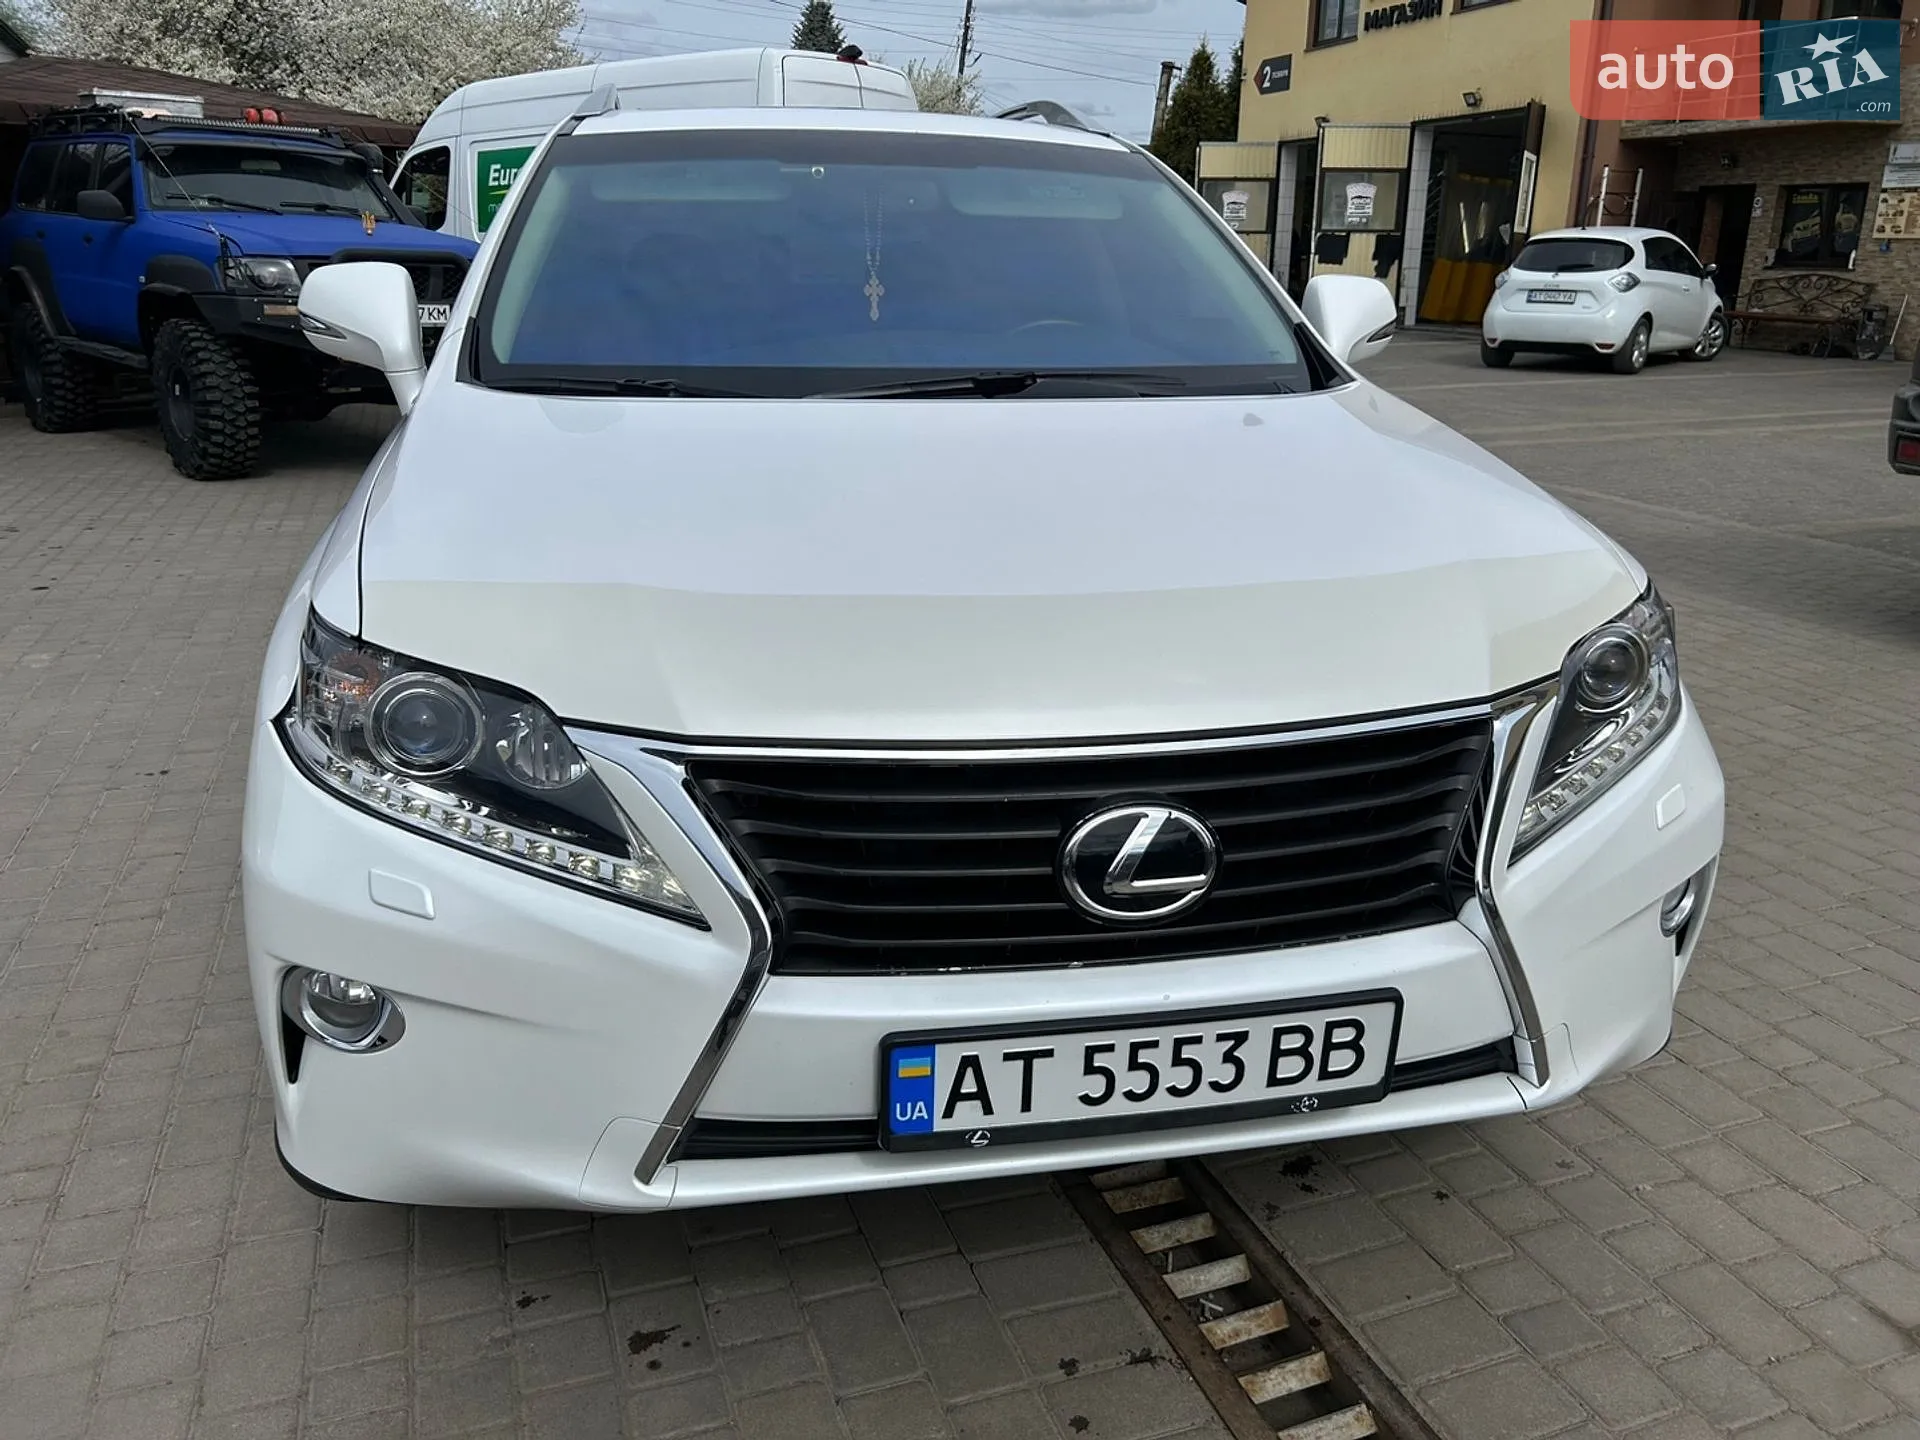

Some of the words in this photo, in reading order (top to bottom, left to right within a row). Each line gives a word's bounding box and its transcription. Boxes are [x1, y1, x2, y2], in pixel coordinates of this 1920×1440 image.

[1261, 65, 1271, 88] 2
[427, 307, 448, 321] KM
[941, 1047, 1055, 1120] AT
[1077, 1029, 1250, 1107] 5553
[1265, 1017, 1367, 1089] BB
[895, 1101, 929, 1123] UA
